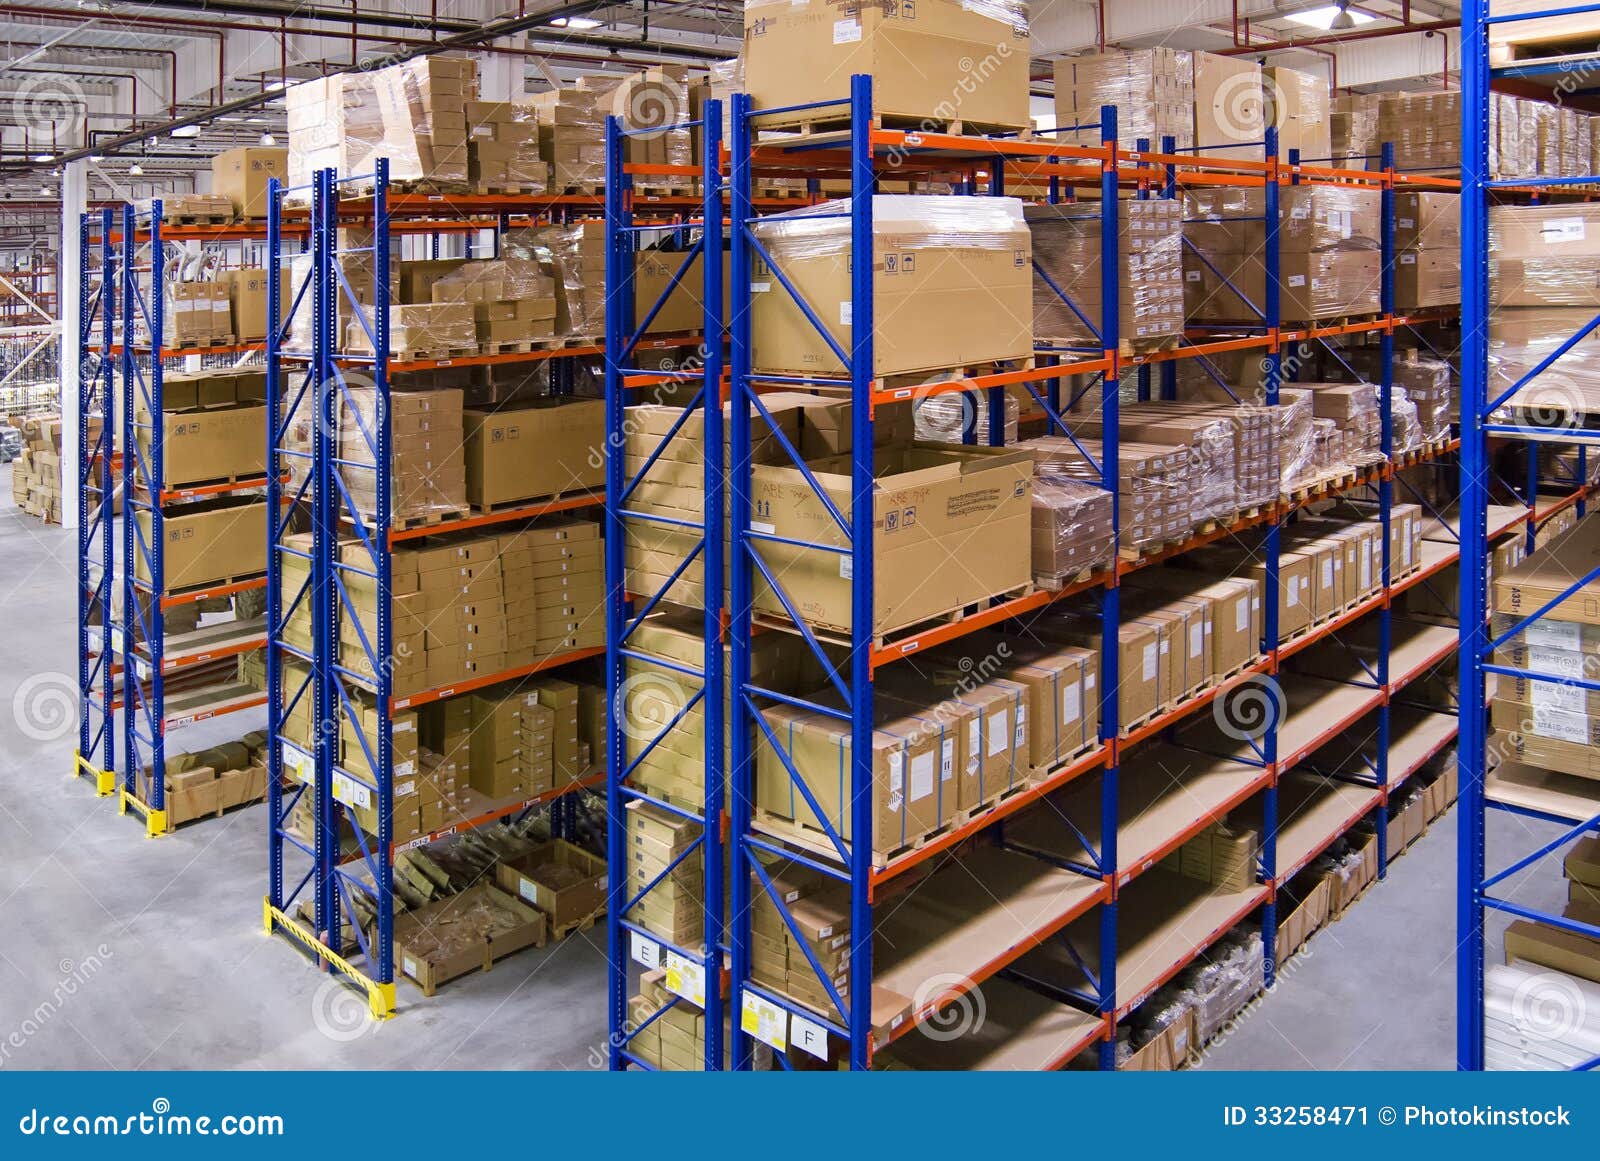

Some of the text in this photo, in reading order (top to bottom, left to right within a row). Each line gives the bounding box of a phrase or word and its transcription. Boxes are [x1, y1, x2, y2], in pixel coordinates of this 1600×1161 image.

[1511, 587, 1521, 613] A331-1
[358, 791, 365, 803] D
[641, 945, 650, 961] E
[805, 1030, 814, 1045] F
